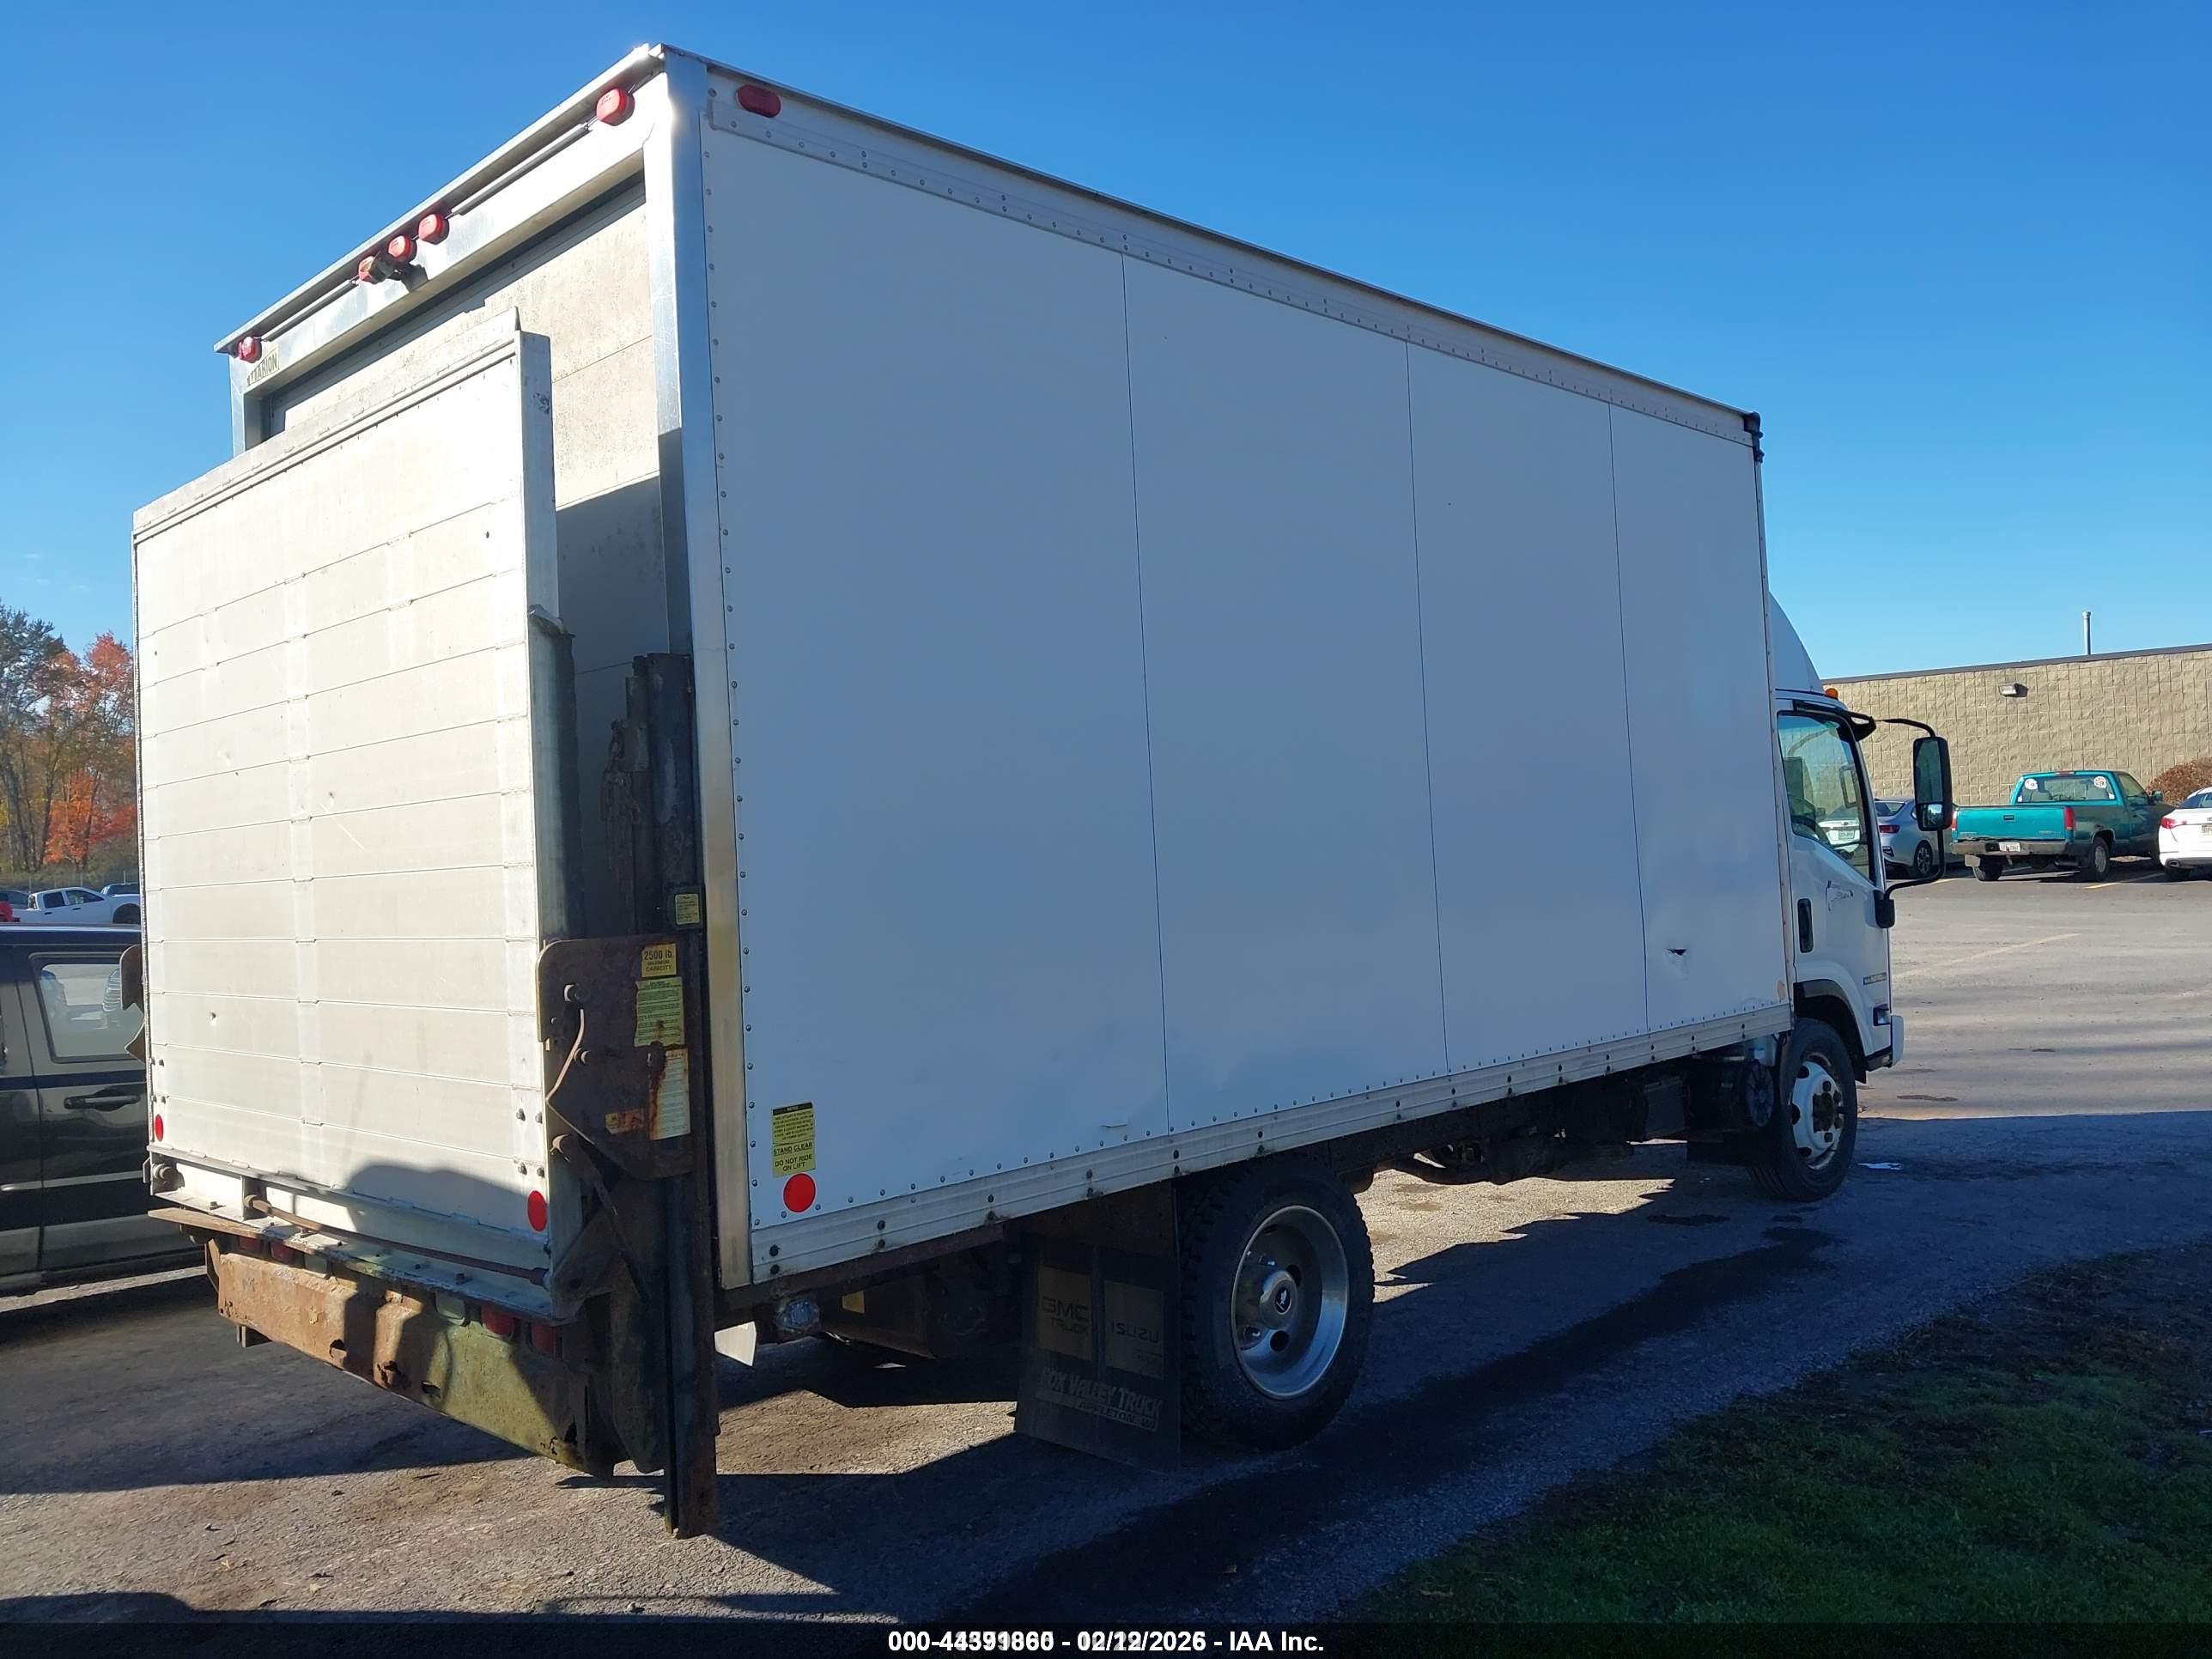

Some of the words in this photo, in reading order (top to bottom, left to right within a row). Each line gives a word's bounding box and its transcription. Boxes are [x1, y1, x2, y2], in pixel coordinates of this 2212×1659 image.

[644, 950, 663, 961] 2500
[773, 1146, 793, 1156] STAND
[793, 1141, 813, 1152] CLEAR
[785, 1157, 798, 1166] NOT
[799, 1153, 813, 1162] RIDE
[1041, 1296, 1089, 1322] GMC
[1050, 1317, 1089, 1337] TRUCK
[1112, 1321, 1159, 1343] ISUZU
[1070, 1373, 1116, 1407] VALLEY
[1117, 1386, 1163, 1418] TRUCK
